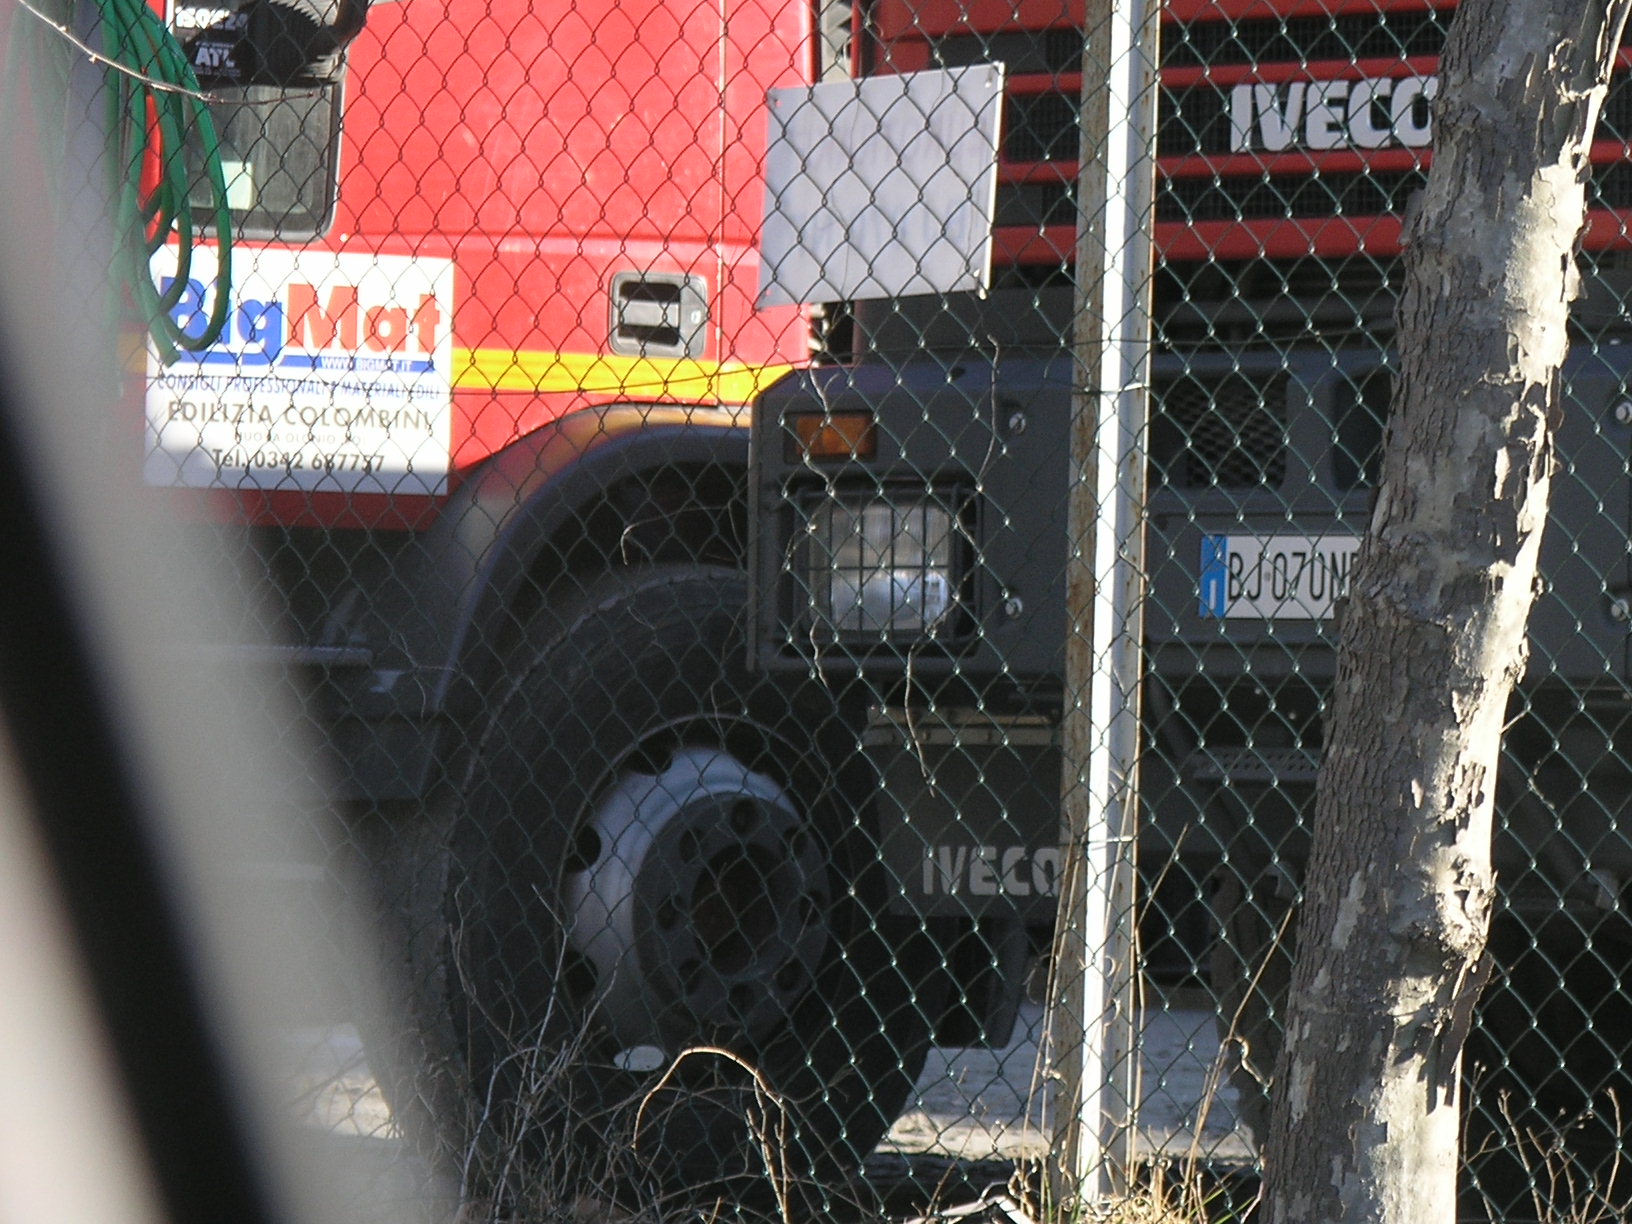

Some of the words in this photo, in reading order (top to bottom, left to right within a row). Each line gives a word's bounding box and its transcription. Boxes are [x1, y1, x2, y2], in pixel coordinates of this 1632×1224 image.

[1230, 76, 1438, 153] IVECO
[320, 356, 413, 373] WWW.BIGMT.IT
[410, 383, 439, 401] DILI
[168, 400, 273, 424] EDILIZIA
[284, 405, 429, 430] COLOMBINI
[212, 449, 246, 468] Tel.
[254, 451, 303, 470] 0342
[1228, 552, 1359, 601] BJ070N
[923, 846, 1059, 896] IVECO
